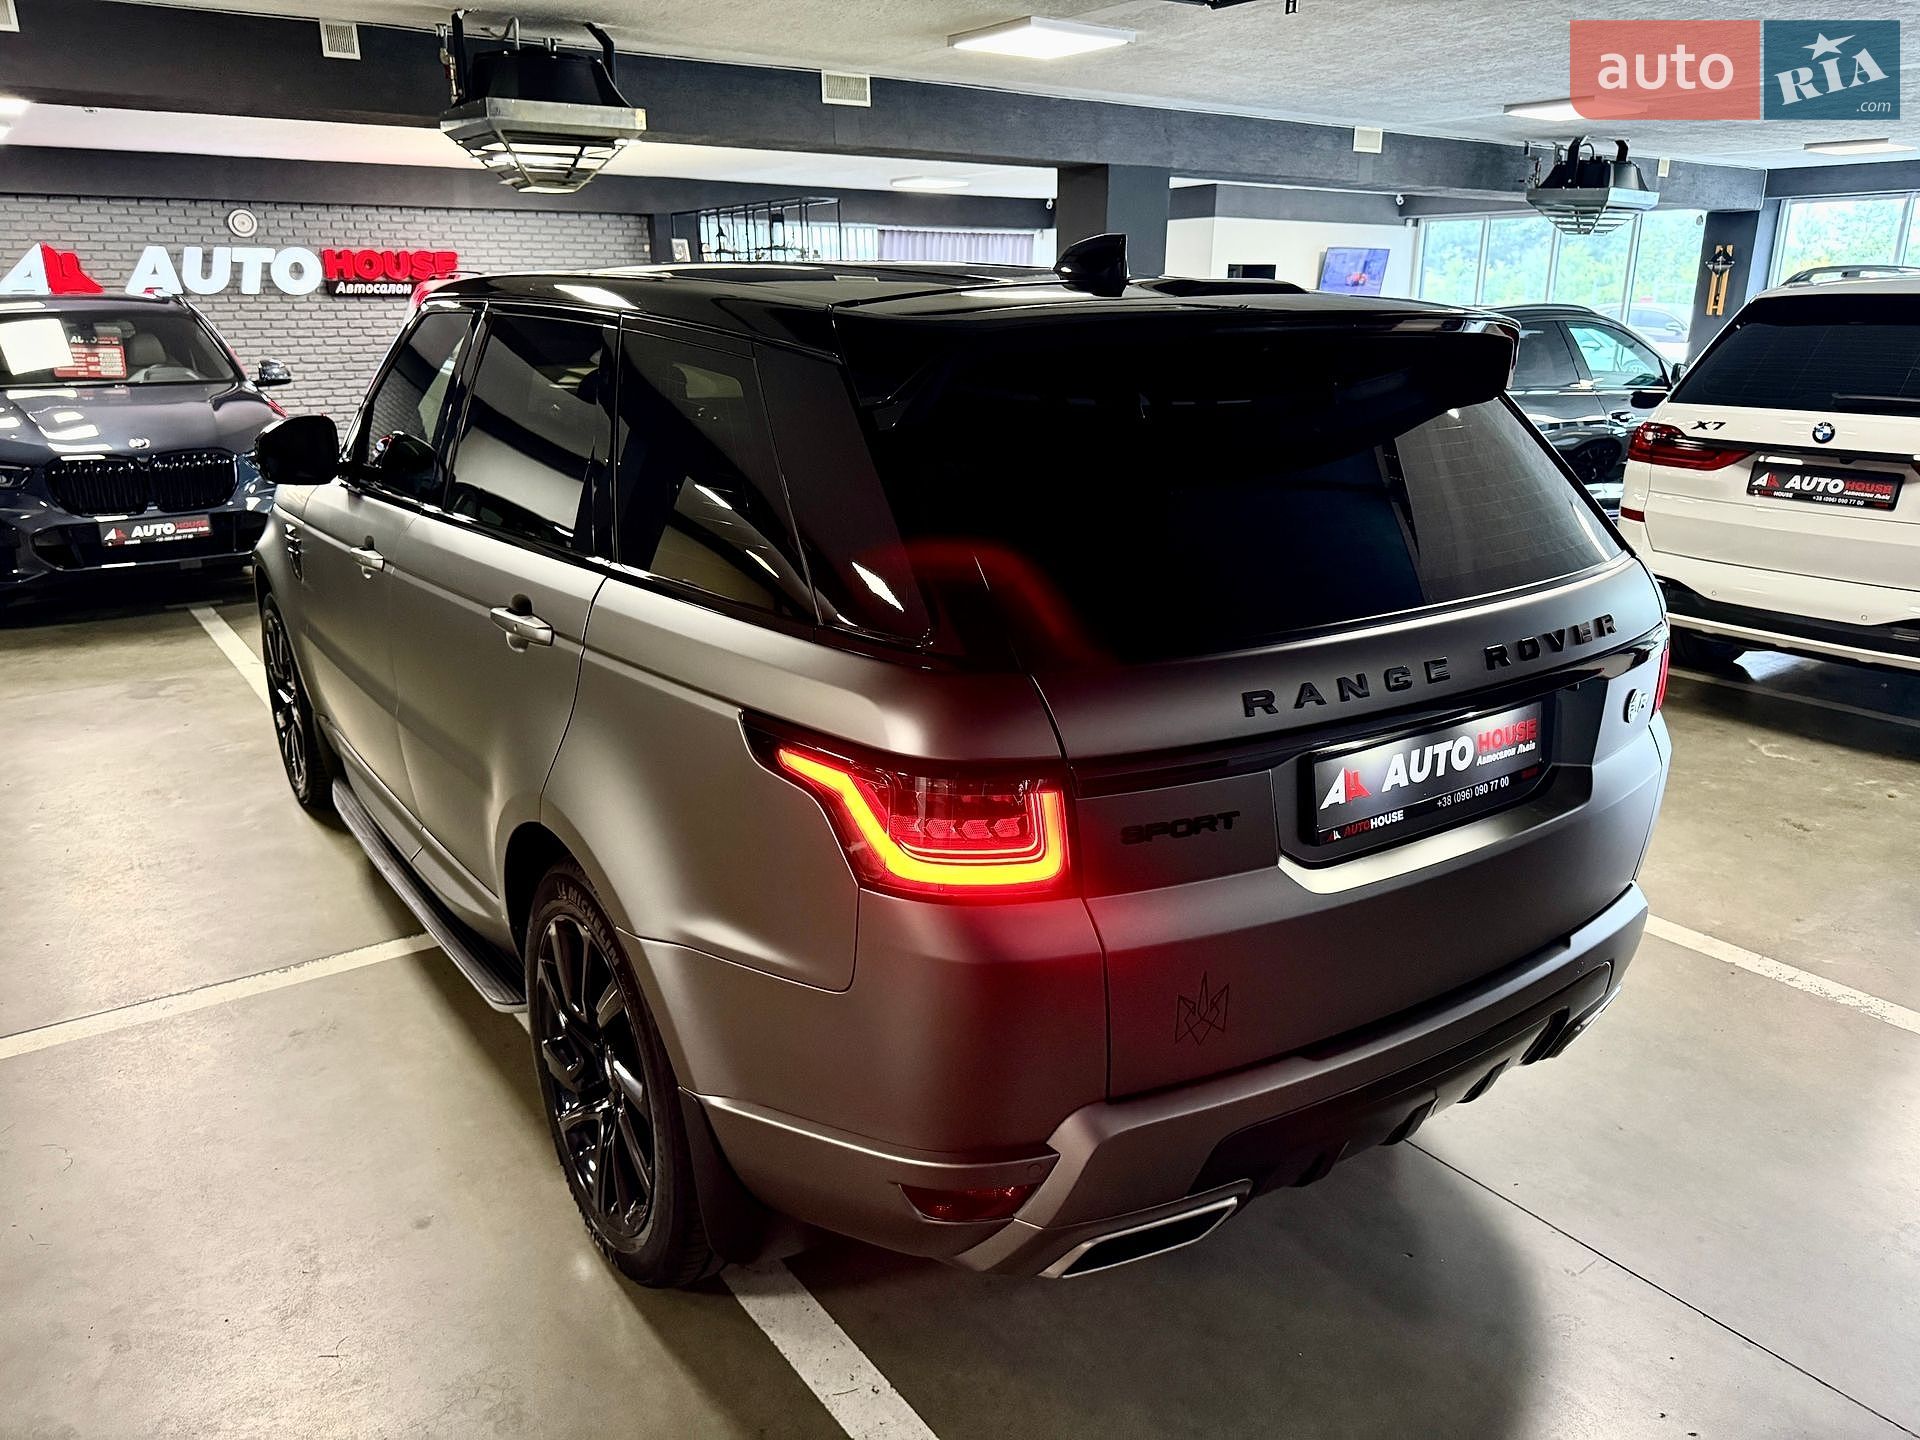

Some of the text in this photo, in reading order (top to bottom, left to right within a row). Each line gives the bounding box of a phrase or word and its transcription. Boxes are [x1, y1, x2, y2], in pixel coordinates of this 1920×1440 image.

[124, 246, 458, 297] AUTO HOUSE
[335, 281, 412, 296] Автосалон
[1691, 420, 1727, 431] X7
[1784, 474, 1894, 494] AUTO HOUSE
[131, 522, 176, 538] AUTO
[1241, 613, 1618, 718] RANGE ROVER
[1381, 718, 1538, 793] AUTO HOUSE
[1437, 776, 1510, 808] +38 (096) 090 77 00
[1121, 810, 1241, 845] SPORT
[567, 885, 620, 967] MICHELIN
